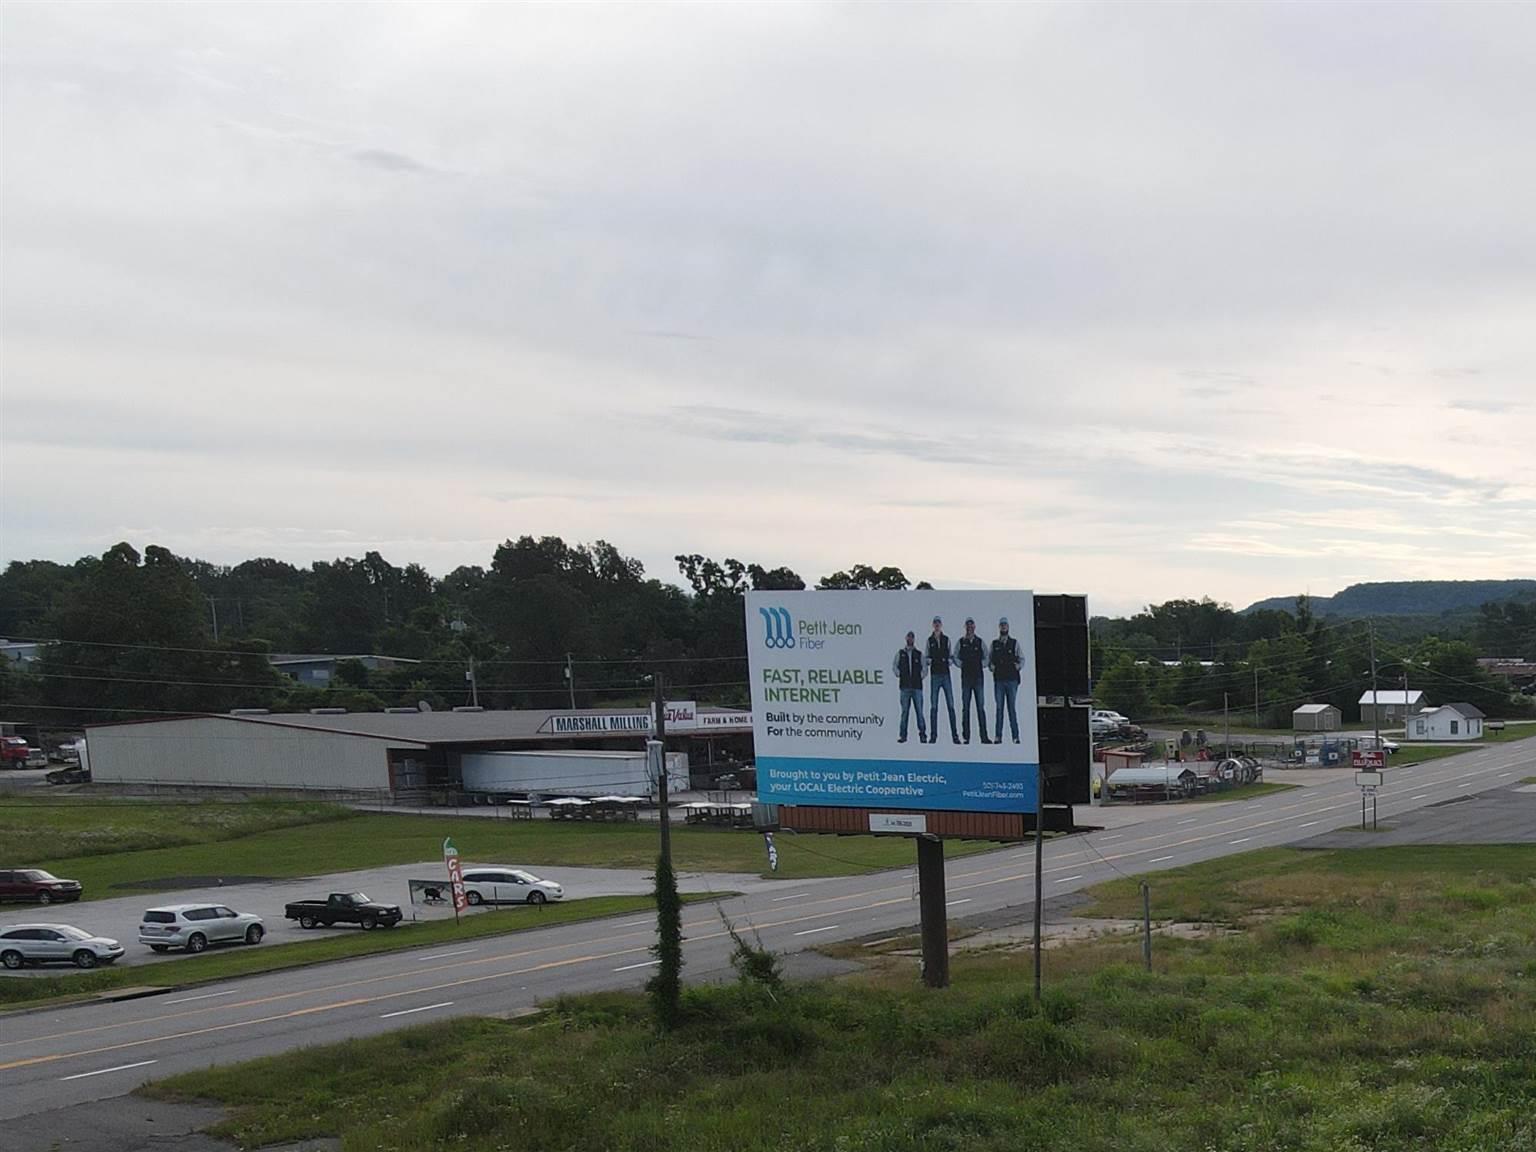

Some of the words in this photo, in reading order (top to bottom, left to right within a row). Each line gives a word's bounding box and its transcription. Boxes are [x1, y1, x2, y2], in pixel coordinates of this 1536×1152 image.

[798, 620, 827, 635] Petit
[830, 620, 862, 635] Jean
[799, 637, 825, 650] Fiber
[763, 669, 804, 686] FAST,
[808, 669, 884, 685] RELIABLE
[764, 688, 840, 703] INTERNET
[556, 716, 607, 732] MARSHALL
[609, 716, 649, 730] MILLING
[729, 716, 748, 724] HOME
[766, 712, 791, 722] Built
[792, 713, 805, 725] by
[807, 713, 824, 723] the
[826, 713, 885, 727] community
[767, 726, 784, 736] For
[786, 727, 803, 737] the
[805, 728, 863, 740] community
[769, 769, 808, 781] Brought
[810, 771, 821, 779] to
[823, 773, 840, 782] you
[843, 771, 855, 782] by
[857, 772, 880, 782] Petit
[881, 772, 905, 783] Jean
[907, 773, 947, 785] Electric,
[770, 783, 792, 793] your
[794, 782, 826, 793] LOCAL
[828, 783, 864, 794] Electric
[866, 785, 924, 796] Cooperative
[448, 859, 465, 908] CARS
